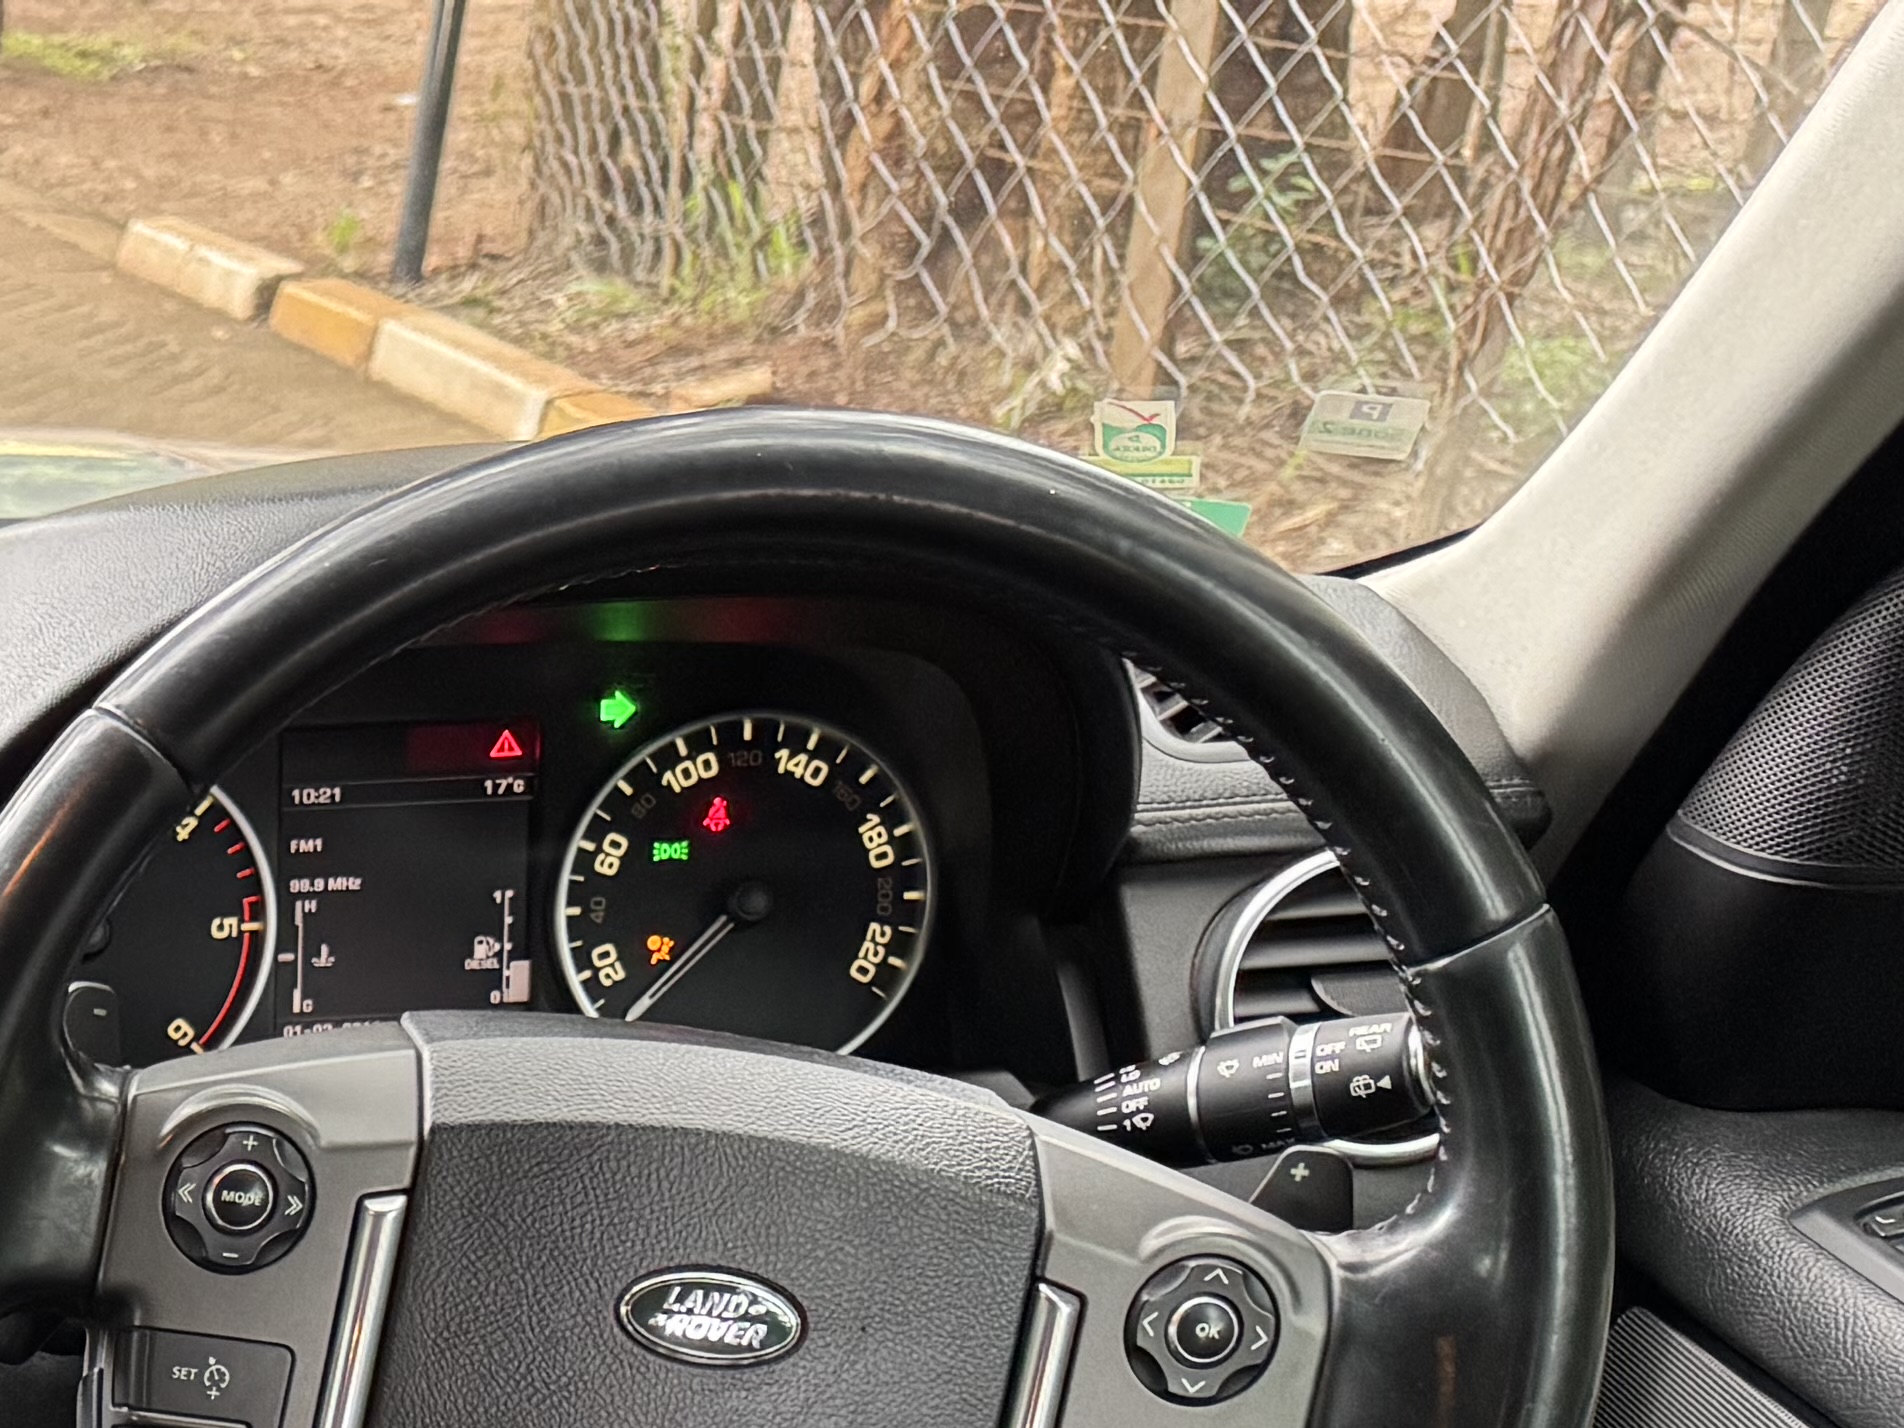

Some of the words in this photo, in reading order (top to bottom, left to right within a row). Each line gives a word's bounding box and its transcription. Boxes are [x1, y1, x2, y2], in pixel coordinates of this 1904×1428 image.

[727, 750, 762, 768] 120
[775, 748, 829, 787] 140
[661, 752, 720, 793] 100
[291, 786, 341, 804] 10:21
[631, 792, 657, 820] 80
[832, 780, 861, 811] 160
[176, 814, 199, 842] 4
[290, 839, 323, 854] FM1
[858, 813, 895, 869] 180
[593, 832, 629, 876] 60
[328, 875, 362, 892] MHz
[876, 877, 893, 917] 200
[590, 896, 607, 925] 40
[210, 917, 238, 940] 5
[464, 957, 500, 971] DIESEL
[850, 921, 892, 984] 220
[591, 943, 626, 987] 20
[166, 1018, 195, 1047] 6
[1348, 1023, 1393, 1037] REAR
[1252, 1051, 1284, 1069] MIN
[1315, 1041, 1346, 1057] OFF
[1315, 1059, 1340, 1074] ON
[1121, 1078, 1161, 1097] AUTO
[1121, 1096, 1149, 1113] OFF
[220, 1189, 263, 1207] MODE
[662, 1285, 748, 1319] LAND
[664, 1311, 768, 1349] ROVER
[1195, 1322, 1220, 1340] OK
[171, 1366, 198, 1381] SET
